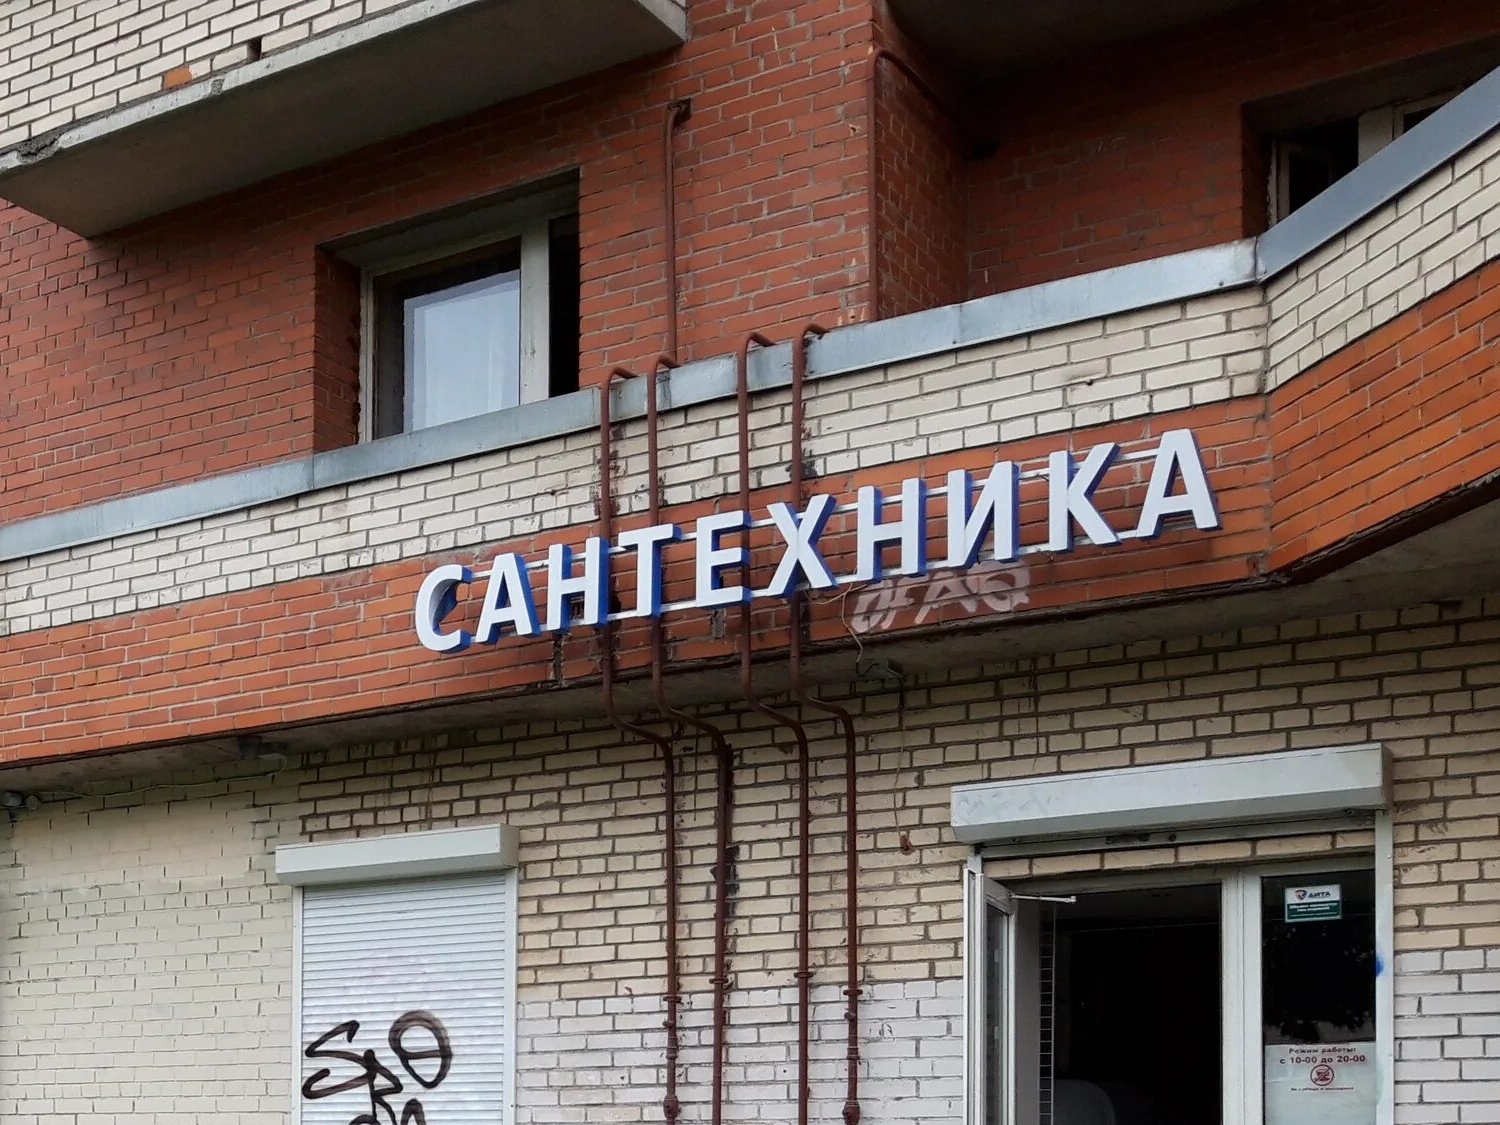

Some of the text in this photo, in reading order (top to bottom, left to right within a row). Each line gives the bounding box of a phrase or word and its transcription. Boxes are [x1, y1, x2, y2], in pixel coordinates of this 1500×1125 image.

[414, 428, 1221, 653] САНТЕХНИКА
[1290, 1056, 1317, 1064] 10-00
[1336, 1054, 1366, 1063] 20-00
